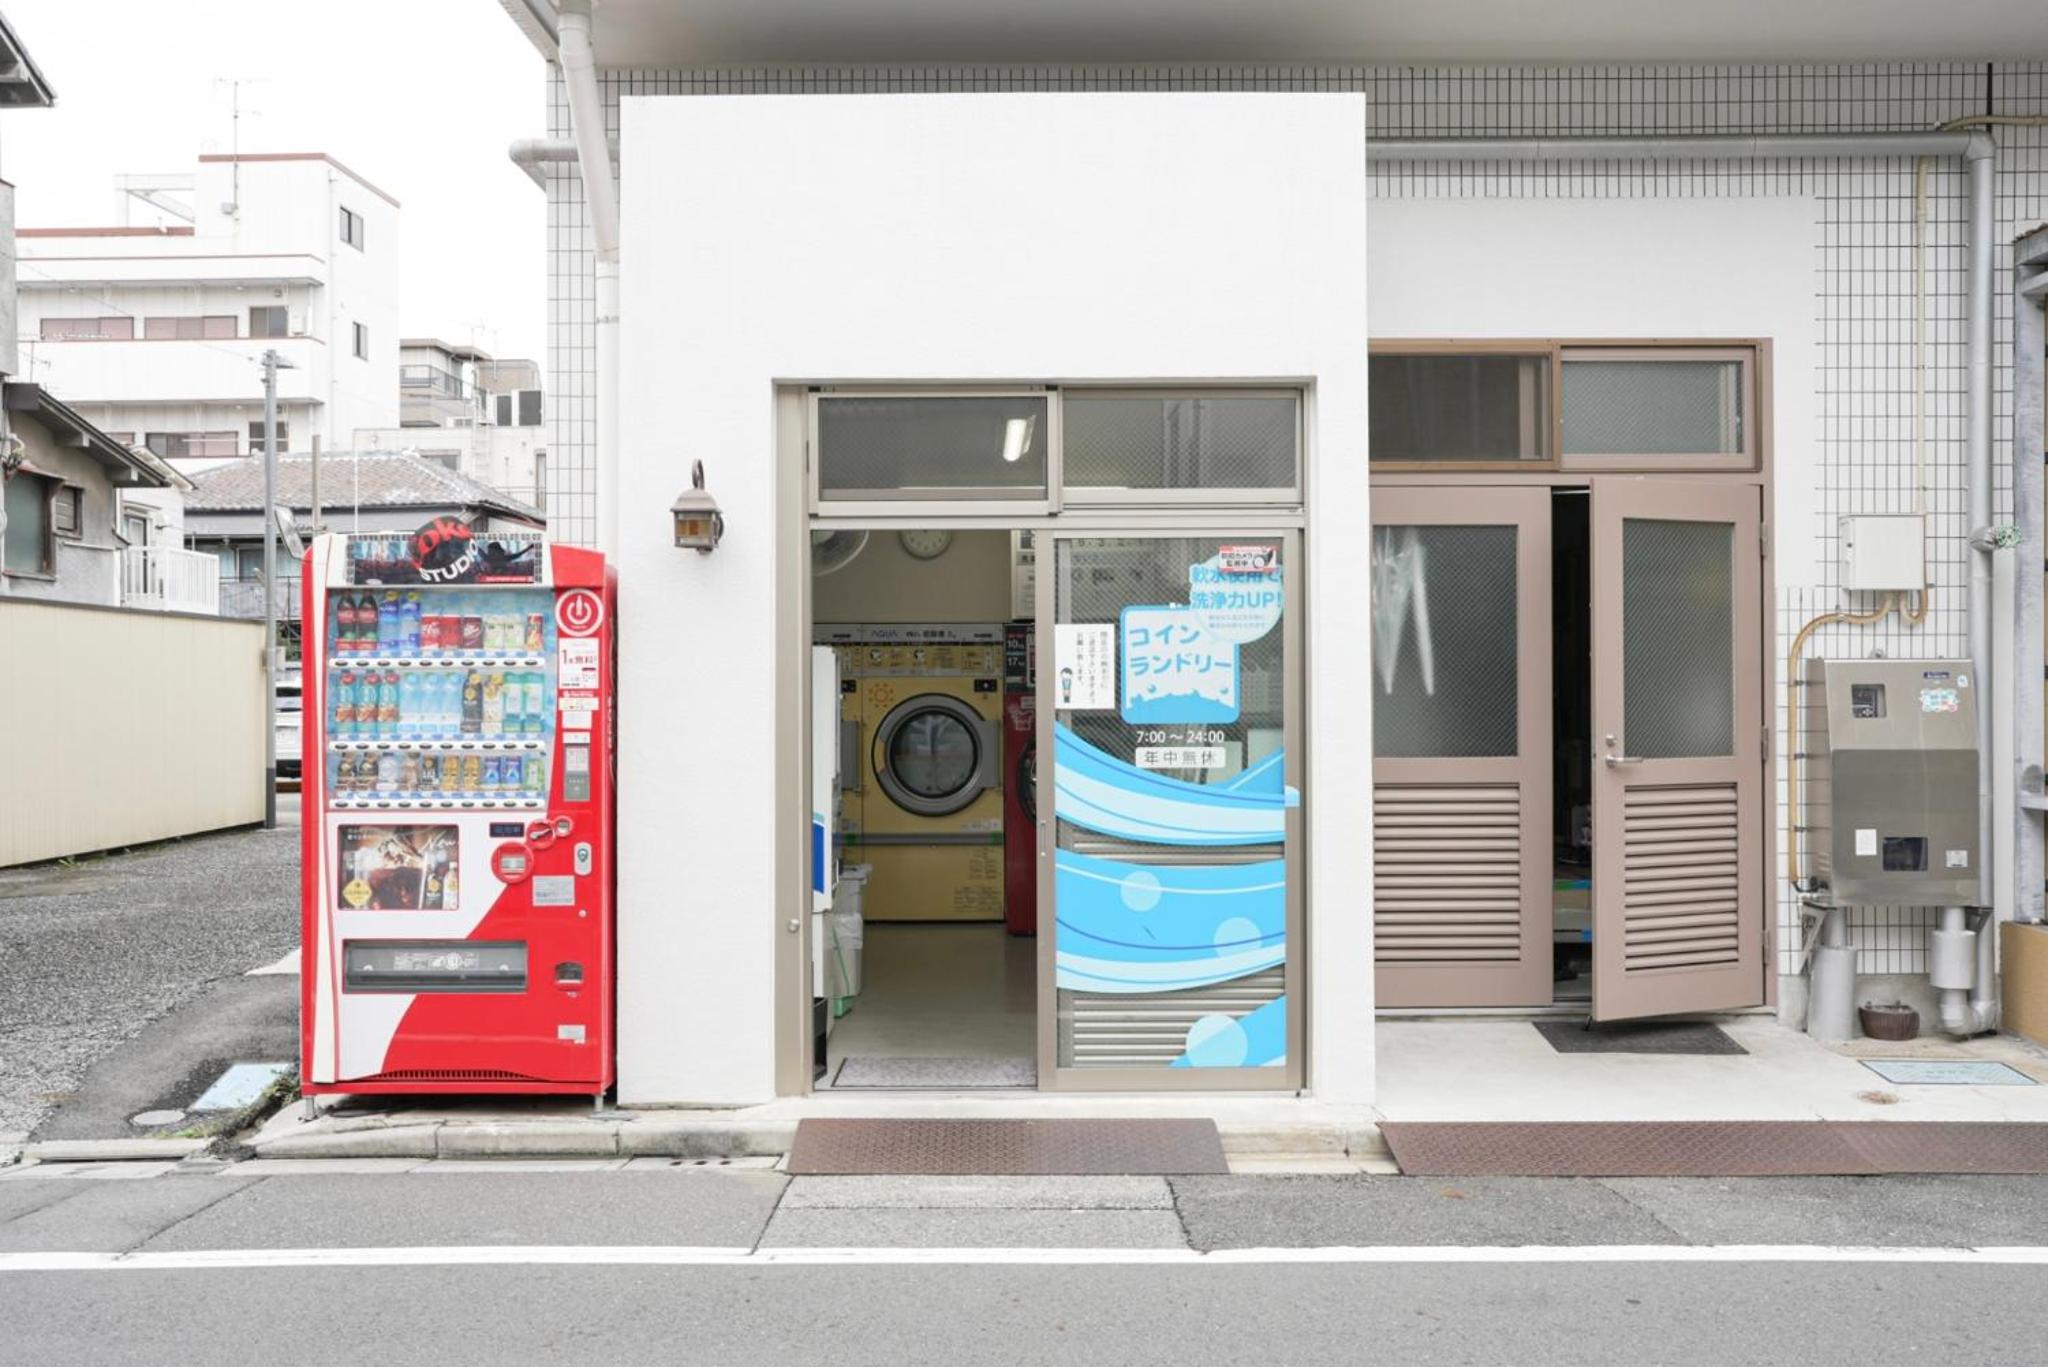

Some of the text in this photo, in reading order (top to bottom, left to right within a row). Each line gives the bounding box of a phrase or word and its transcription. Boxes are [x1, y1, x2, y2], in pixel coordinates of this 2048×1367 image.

[419, 538, 479, 583] STUDIO
[1129, 623, 1201, 647] コイン
[1130, 653, 1232, 676] ランドリー
[1136, 730, 1166, 743] 7:00
[1187, 730, 1225, 743] 24:00
[1144, 750, 1216, 766] 年中無休
